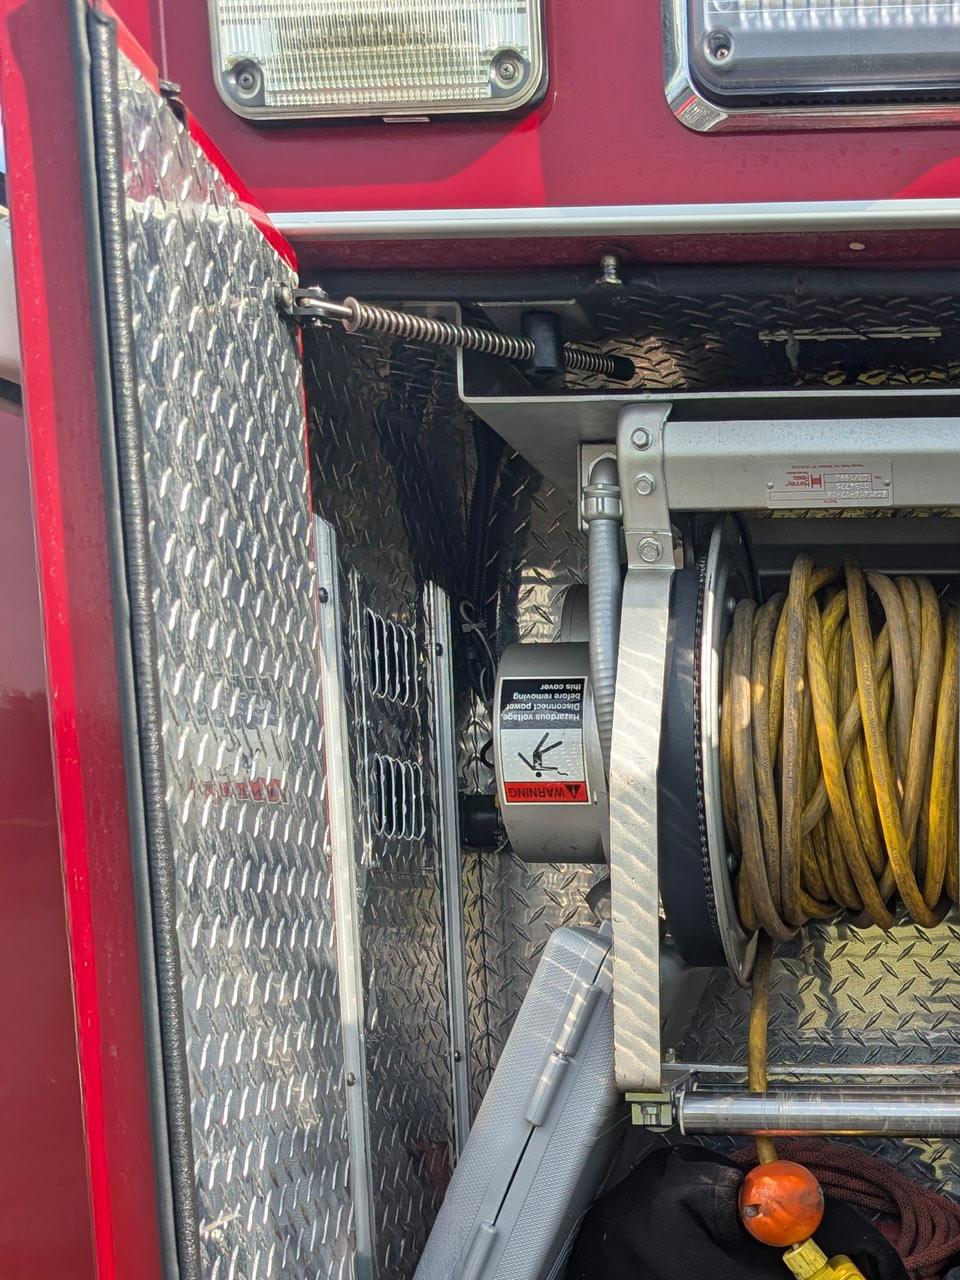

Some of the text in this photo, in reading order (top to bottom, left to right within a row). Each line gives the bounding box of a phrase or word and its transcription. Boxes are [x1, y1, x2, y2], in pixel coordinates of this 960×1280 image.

[566, 683, 581, 691] this
[512, 692, 581, 701] before removing
[506, 702, 580, 711] Disconnect power
[535, 713, 580, 721] Hazardous
[508, 786, 565, 798] WARNING
